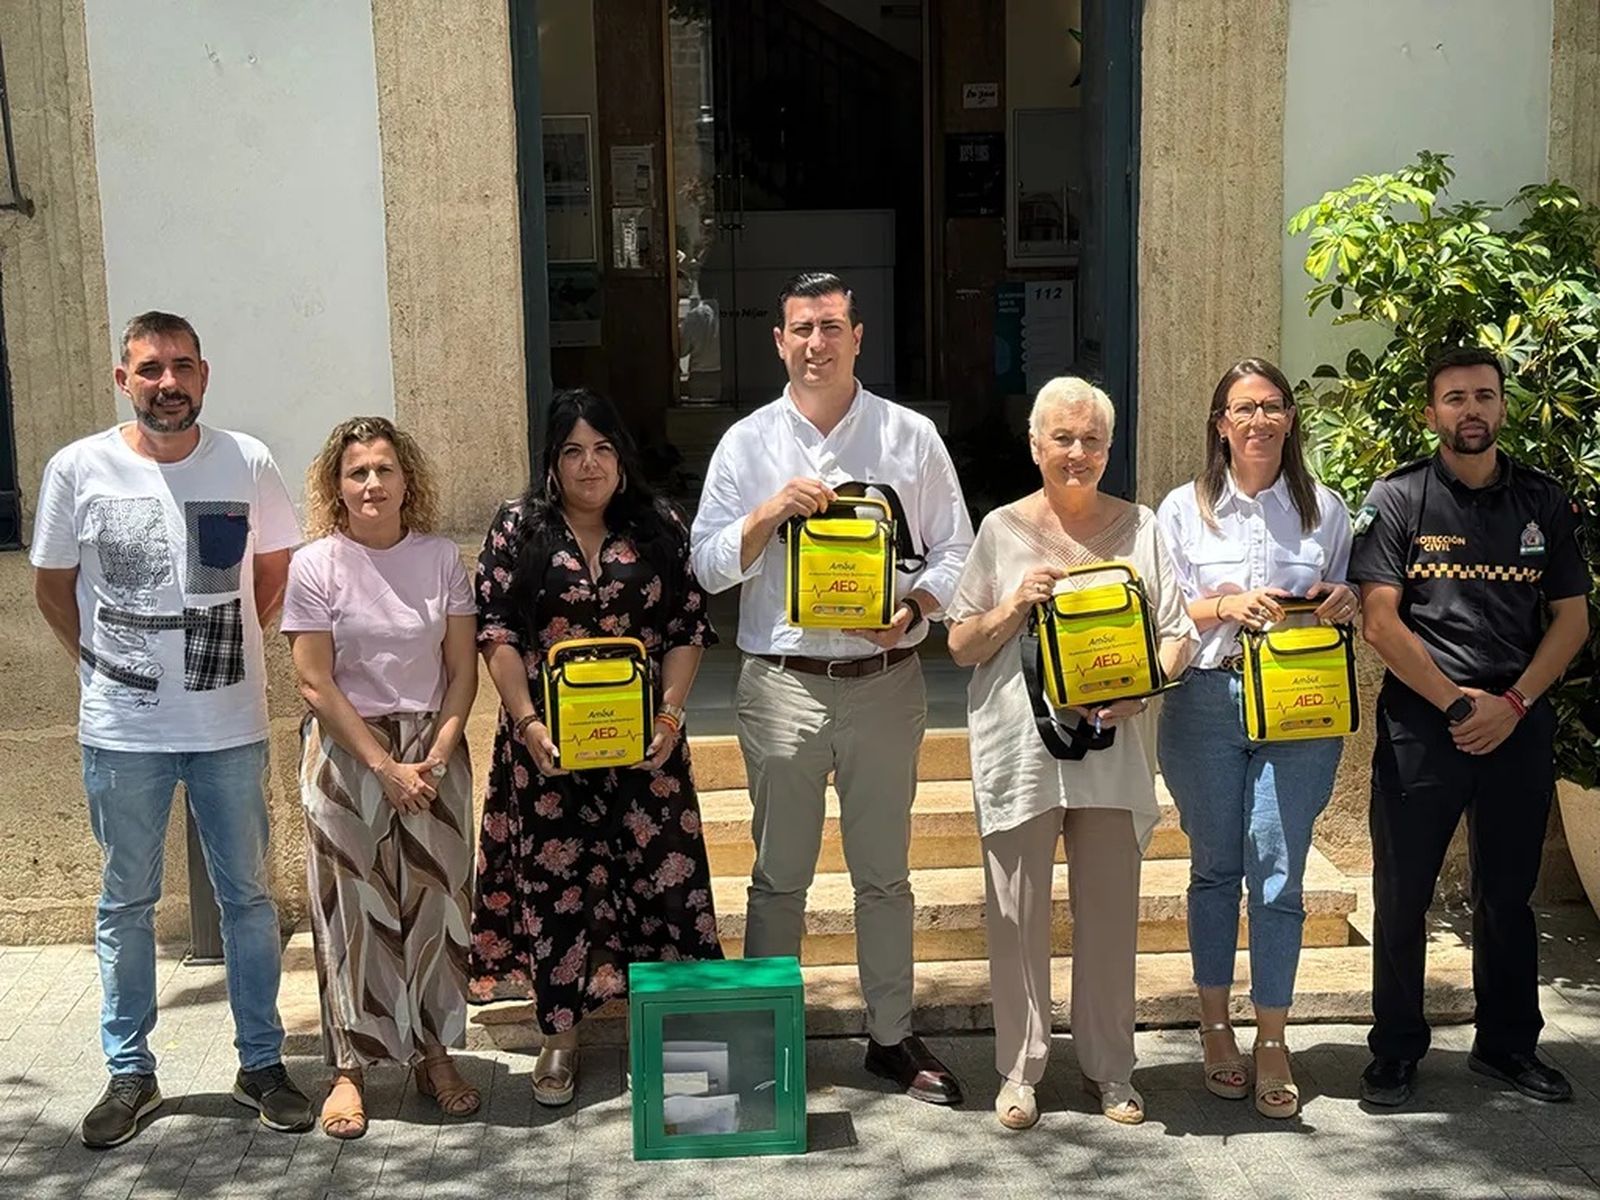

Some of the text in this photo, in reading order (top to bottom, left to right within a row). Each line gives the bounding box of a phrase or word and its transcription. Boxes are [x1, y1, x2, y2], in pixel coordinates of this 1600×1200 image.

[1034, 287, 1063, 300] 112
[1424, 543, 1451, 552] CIVIL
[828, 580, 858, 593] AED
[1091, 653, 1122, 669] AED
[1293, 693, 1323, 707] AED
[588, 727, 618, 740] AED
